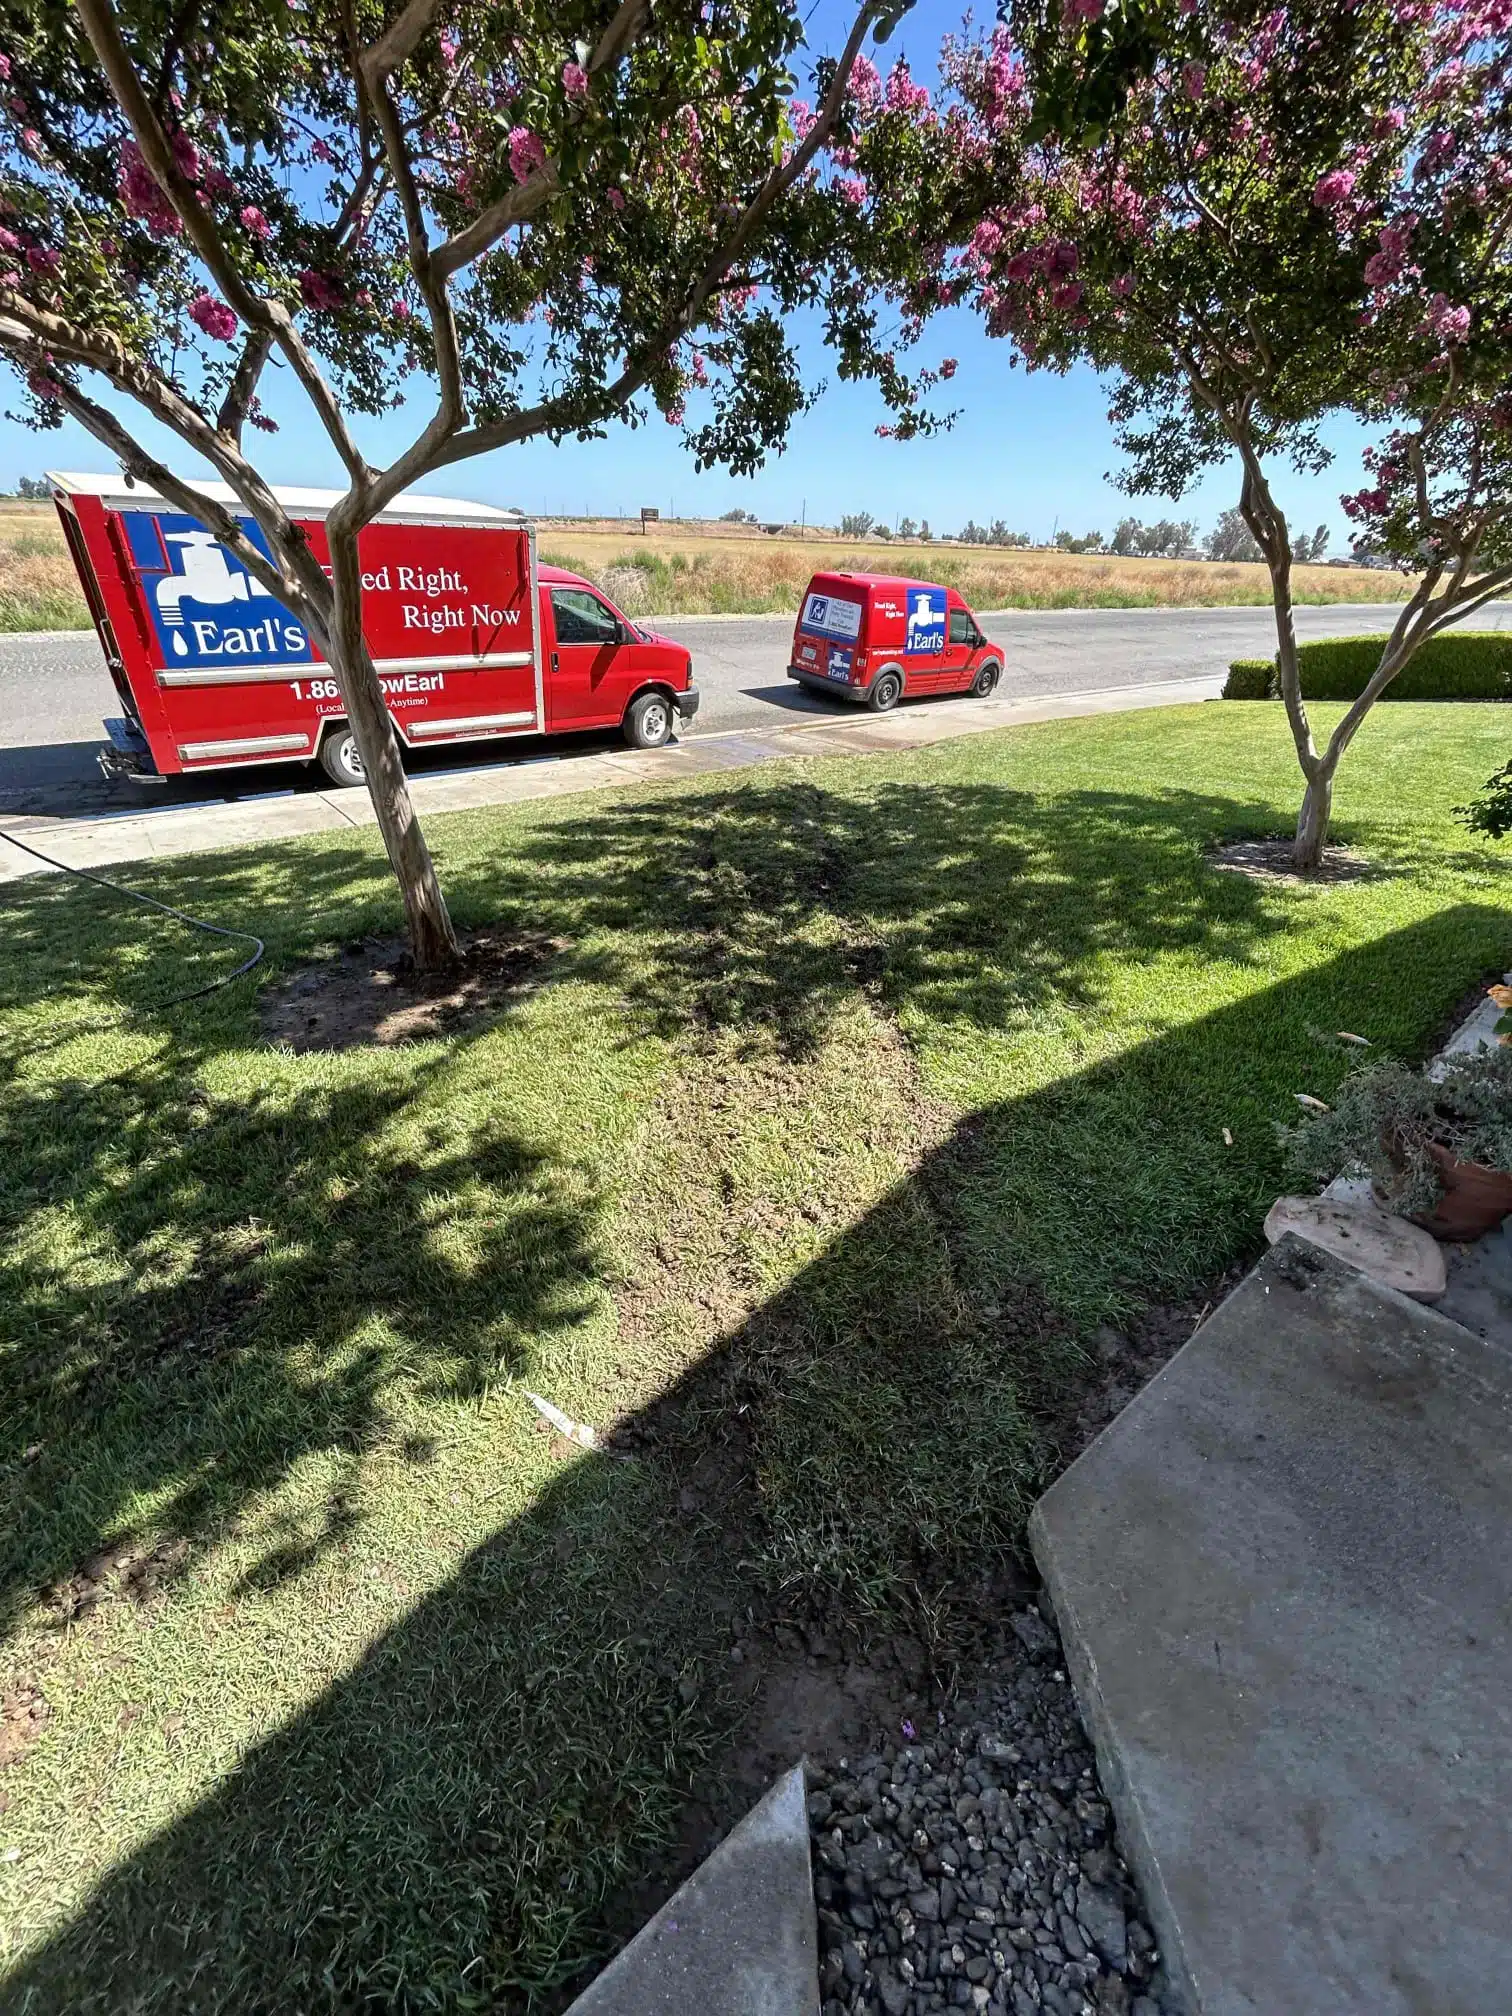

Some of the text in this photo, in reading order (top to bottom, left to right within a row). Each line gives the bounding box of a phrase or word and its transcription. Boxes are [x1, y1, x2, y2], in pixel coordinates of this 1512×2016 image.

[396, 566, 469, 598] Right,
[402, 604, 521, 634] Right Now
[190, 618, 306, 655] Earl's
[914, 631, 944, 649] Earl's
